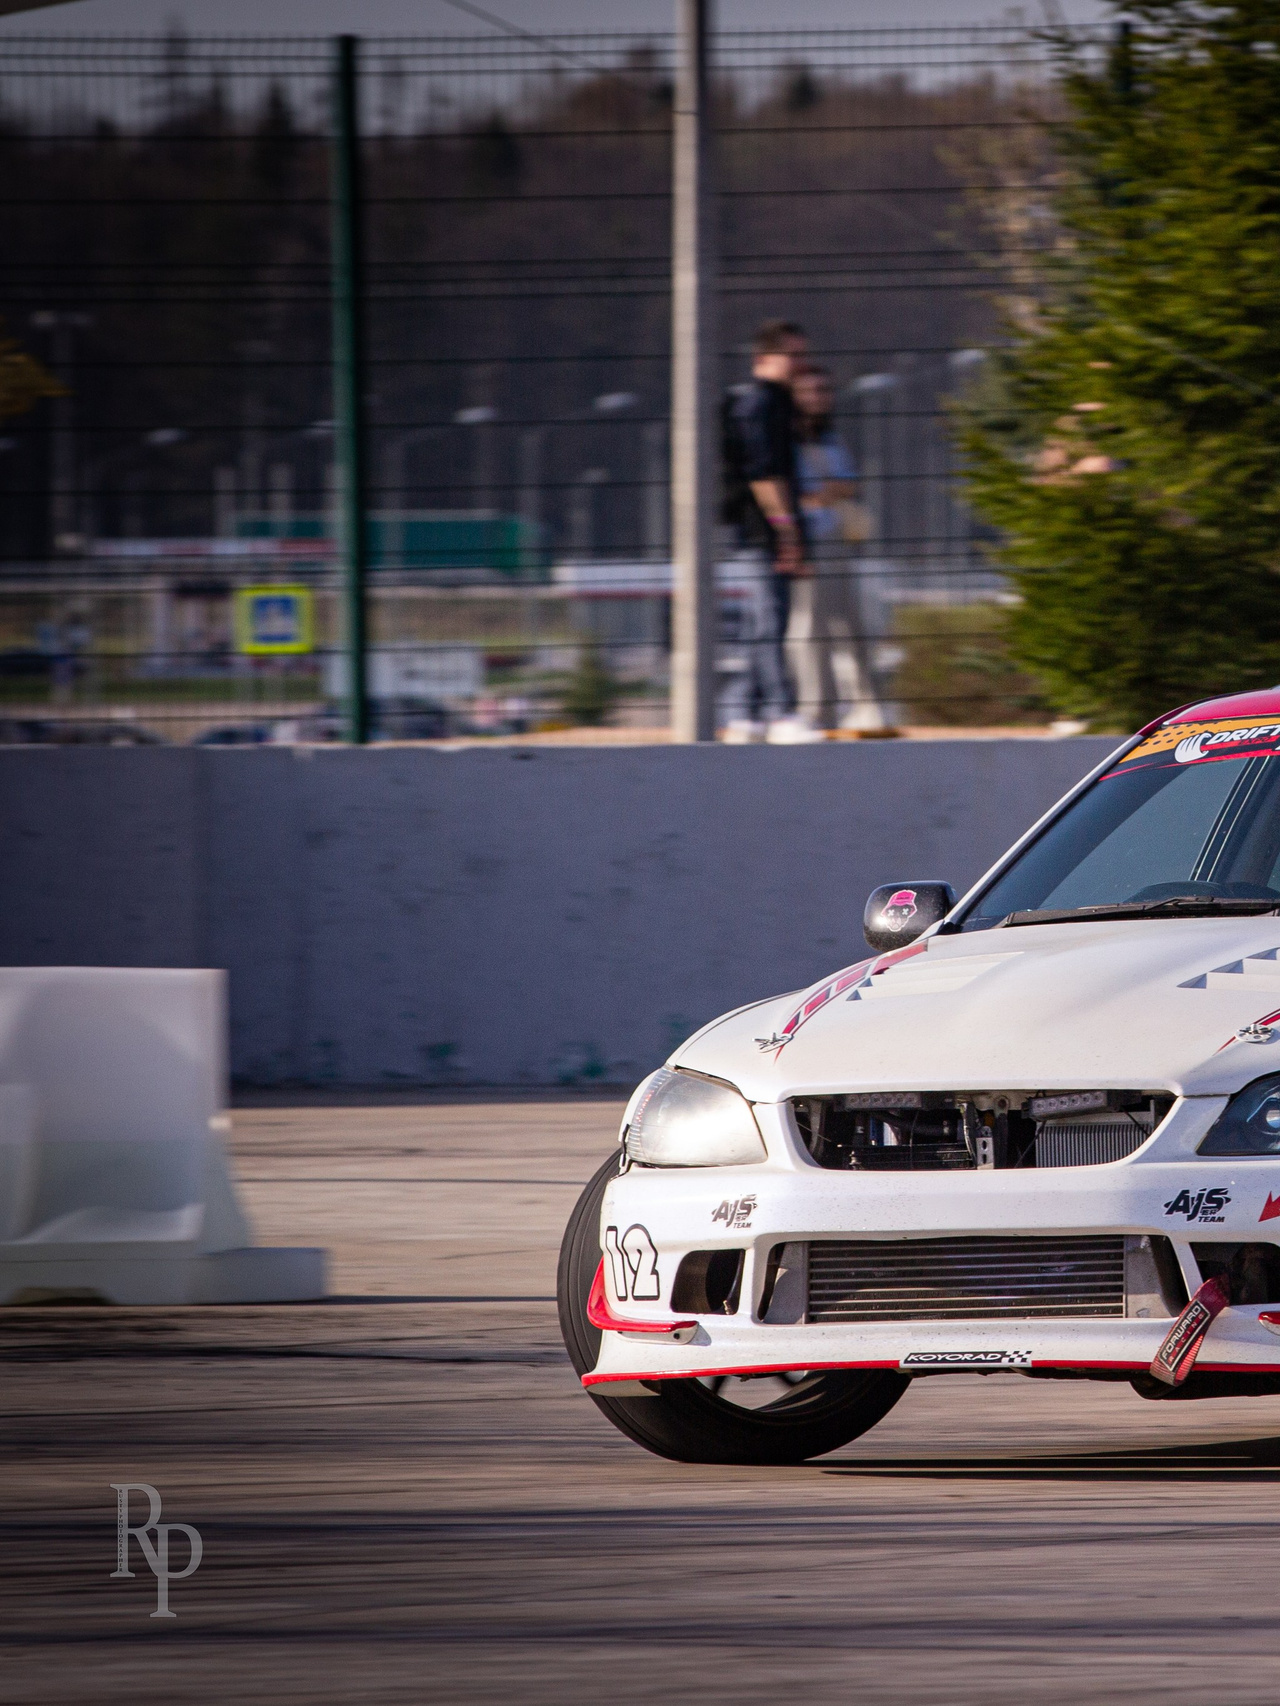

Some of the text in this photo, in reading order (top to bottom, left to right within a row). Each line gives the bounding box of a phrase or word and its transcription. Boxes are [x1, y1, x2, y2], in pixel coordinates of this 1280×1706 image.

[604, 1223, 660, 1301] 12
[907, 1351, 1002, 1364] KOYORAD
[1162, 1305, 1201, 1360] FORWARD
[1167, 1311, 1205, 1364] RACING
